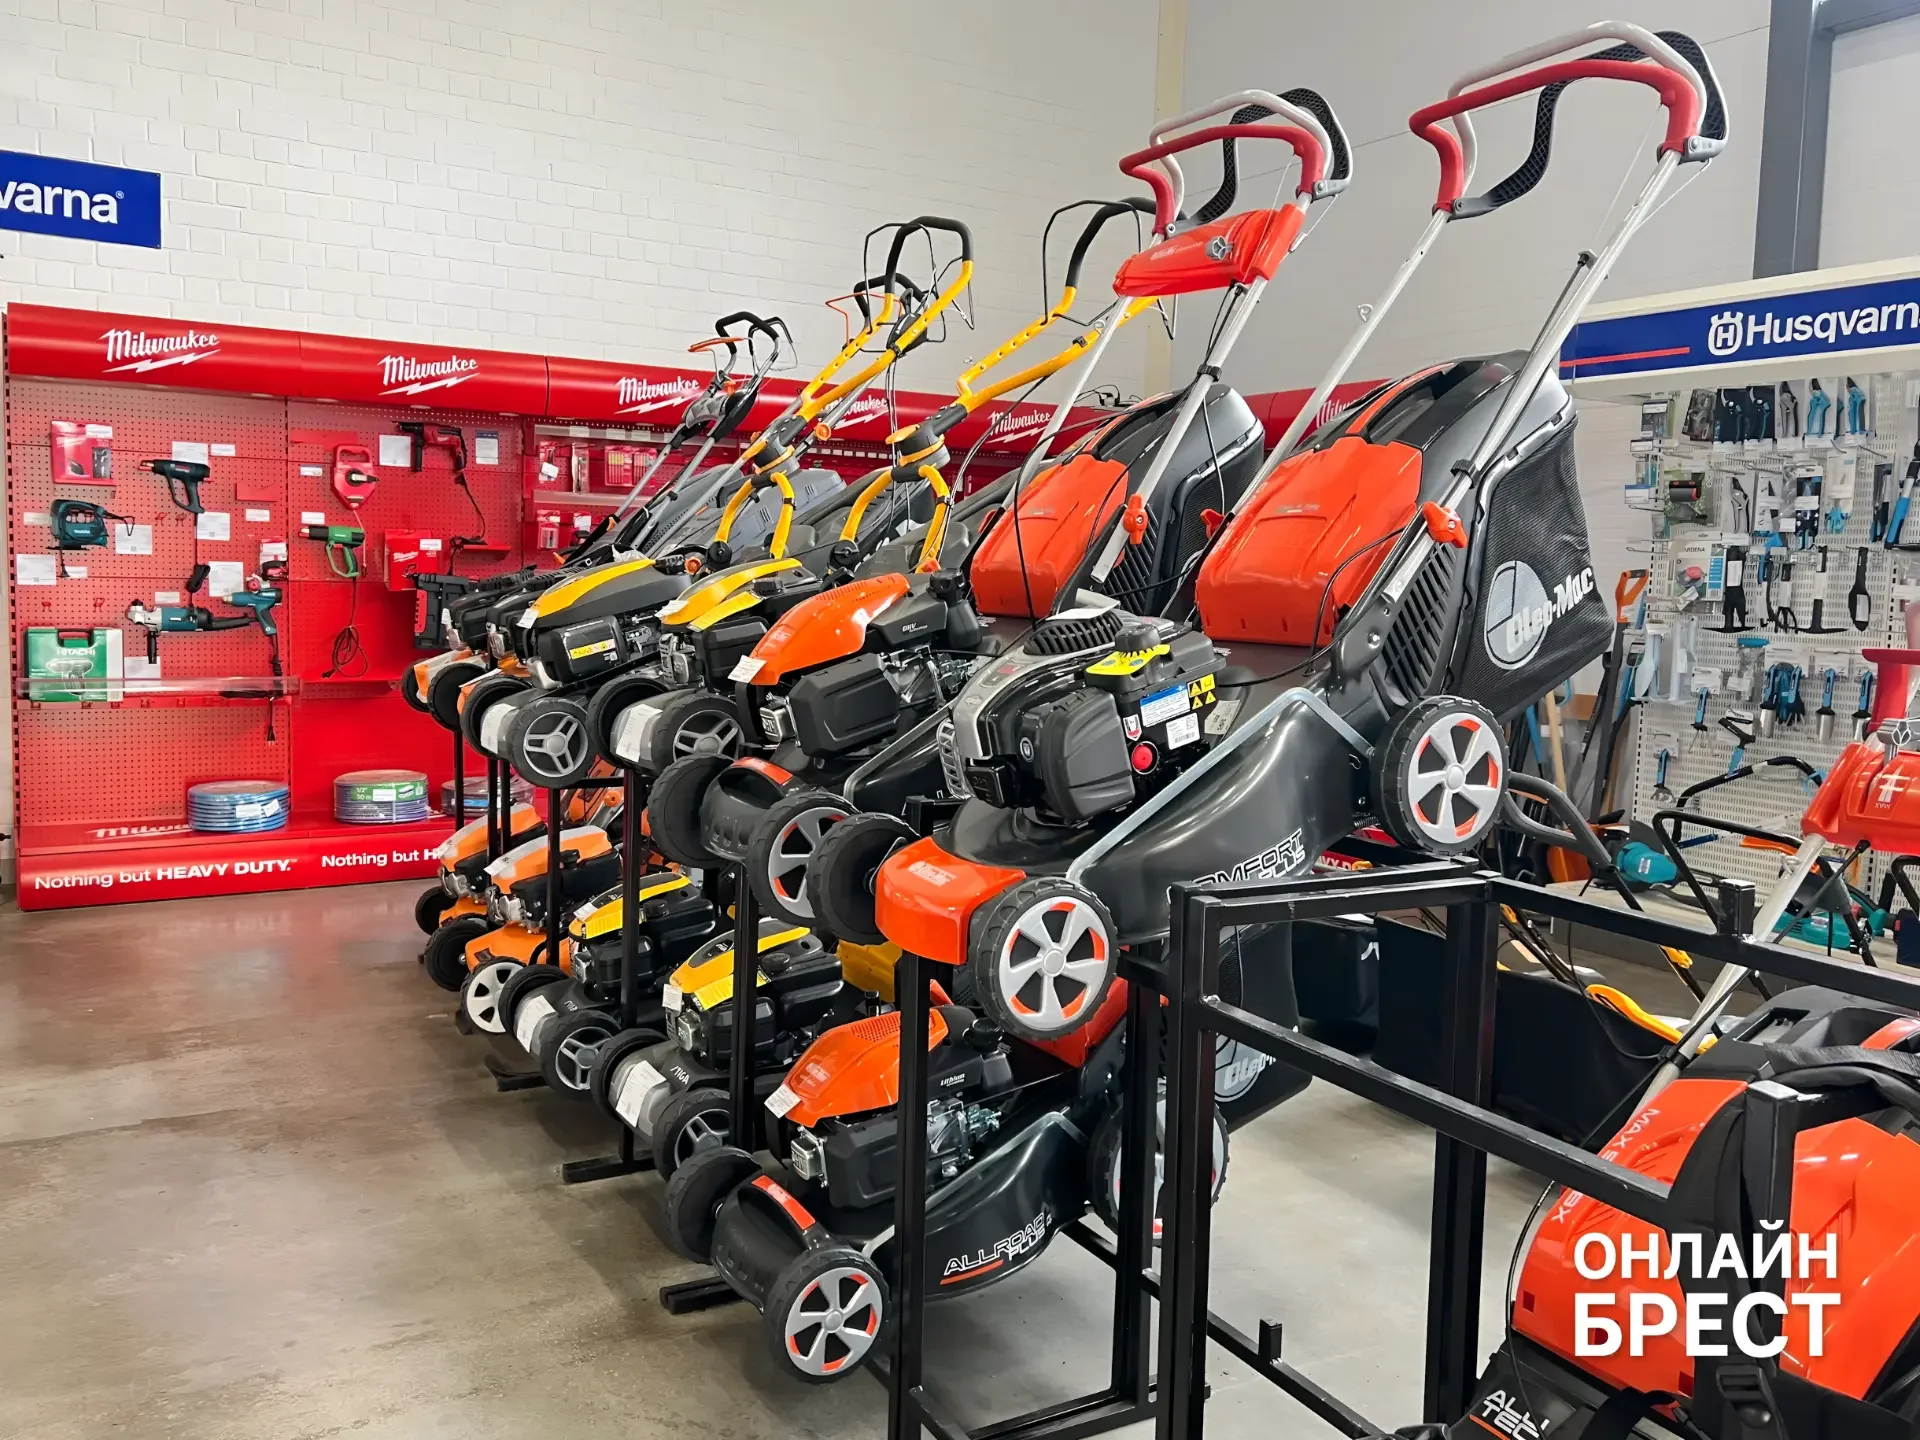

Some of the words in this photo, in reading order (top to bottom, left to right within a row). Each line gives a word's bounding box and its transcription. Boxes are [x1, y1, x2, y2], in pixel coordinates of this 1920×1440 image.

[1746, 302, 1920, 347] Husqvarn
[99, 328, 220, 362] Milwaukee
[378, 355, 479, 385] Milwaukee
[614, 375, 700, 405] Milwaukee
[321, 852, 388, 867] Nothing
[392, 850, 420, 862] but
[34, 872, 114, 890] Nothing
[119, 870, 152, 884] but
[156, 863, 229, 881] HEAVY
[1612, 1108, 1661, 1149] MAX
[943, 1212, 1045, 1276] ALLROAD
